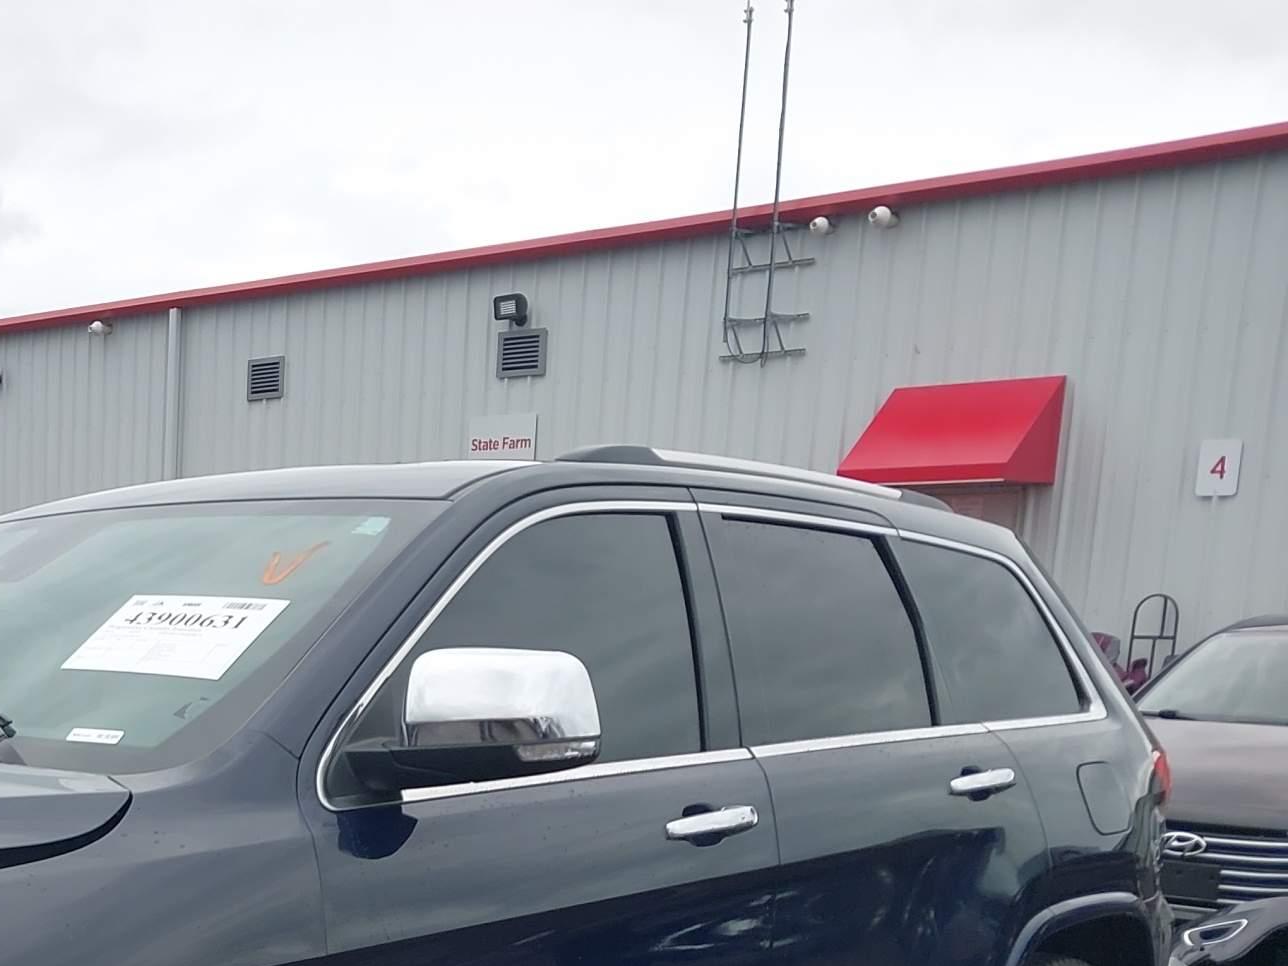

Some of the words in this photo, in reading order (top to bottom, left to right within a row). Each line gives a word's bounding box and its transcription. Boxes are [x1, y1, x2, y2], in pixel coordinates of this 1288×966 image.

[471, 438, 500, 452] State
[502, 436, 531, 450] Farm
[1210, 455, 1226, 480] 4
[124, 611, 249, 630] 43900631
